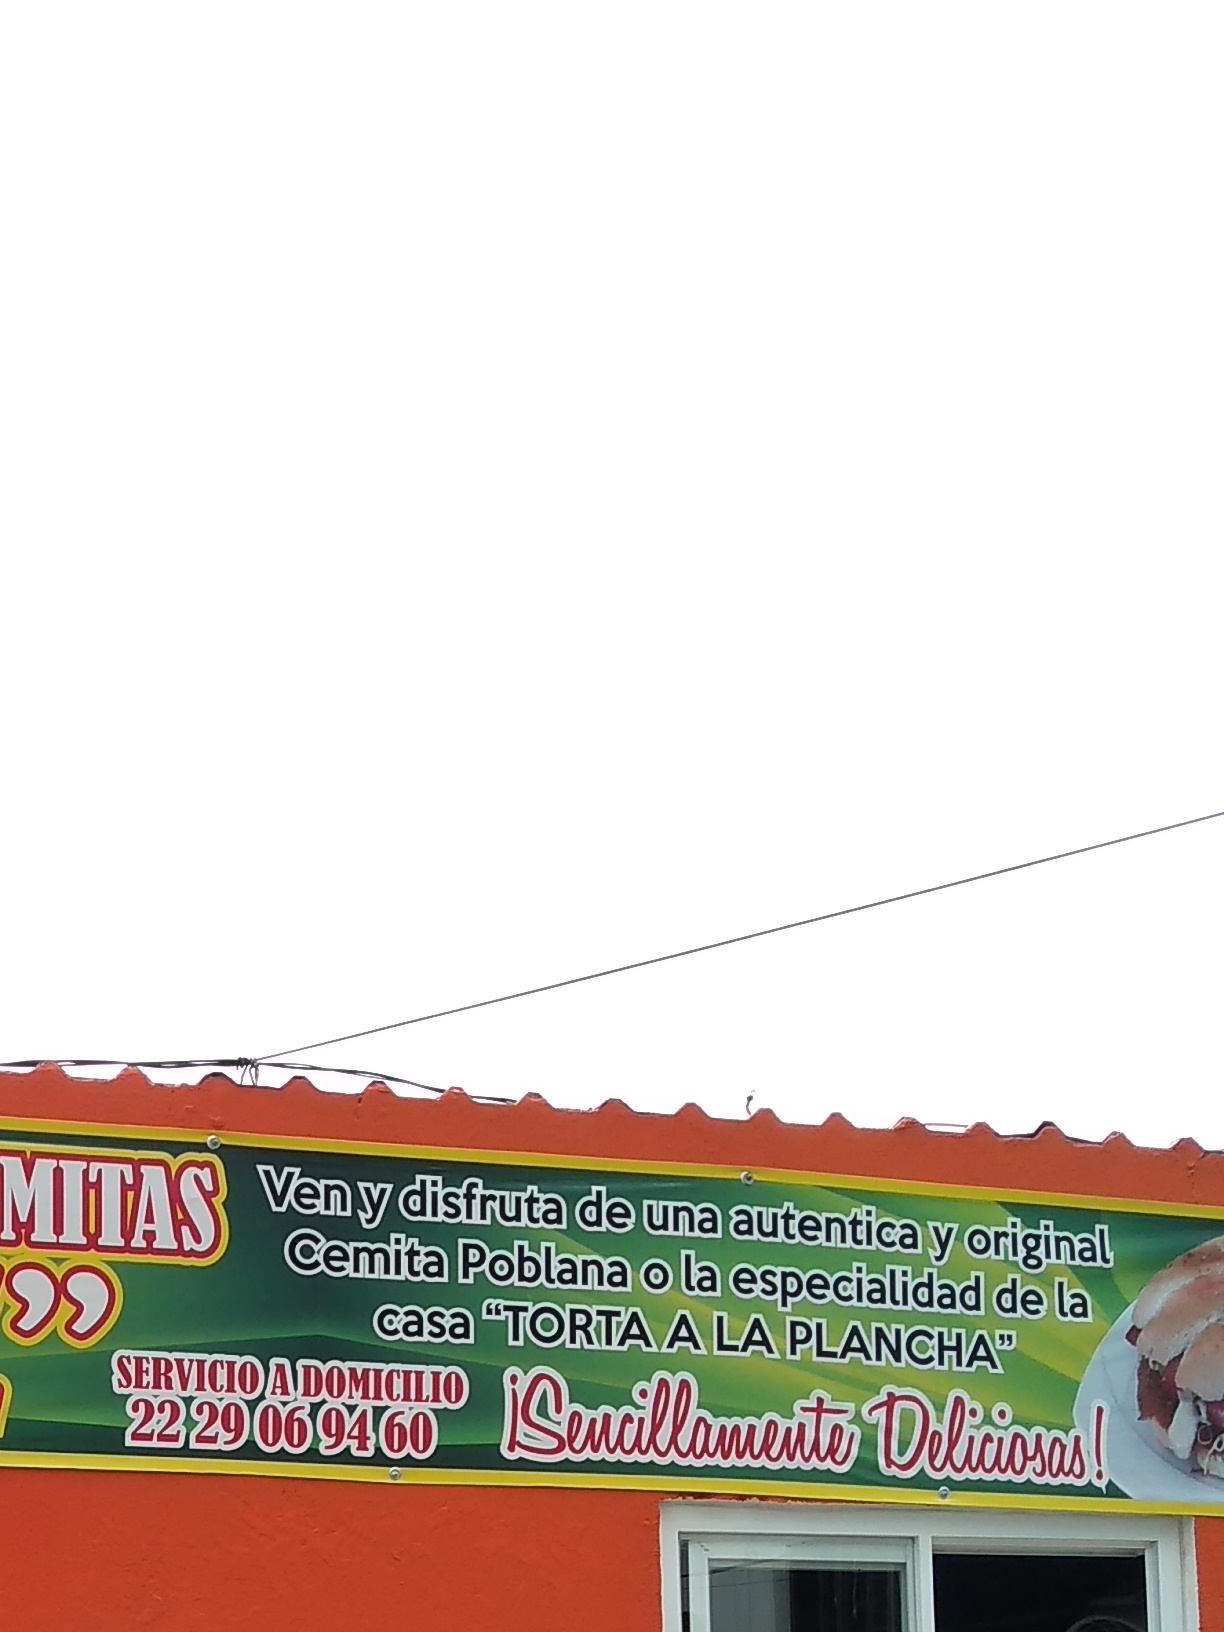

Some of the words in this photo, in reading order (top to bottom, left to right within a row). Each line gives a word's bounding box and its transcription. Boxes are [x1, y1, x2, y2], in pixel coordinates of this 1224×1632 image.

[258, 1165, 351, 1215] Ven
[357, 1181, 391, 1227] y
[399, 1175, 565, 1229] disfruta
[577, 1187, 634, 1231] de
[647, 1201, 720, 1237] una
[731, 1204, 919, 1252] autentica
[930, 1222, 956, 1265] y
[966, 1220, 1111, 1272] original
[286, 1230, 446, 1281] Cemita
[459, 1240, 631, 1292] Poblana
[641, 1260, 670, 1292] o
[683, 1252, 719, 1296] la
[731, 1263, 982, 1310] especialidad
[995, 1275, 1046, 1317] de
[1057, 1279, 1091, 1320] la
[374, 1305, 472, 1342] casa
[663, 1312, 704, 1352] A
[715, 1314, 777, 1357] LA
[116, 1354, 261, 1396] SERVICIO
[270, 1362, 291, 1397] A
[300, 1364, 465, 1405] DOMICILIO
[129, 1398, 182, 1444] 22
[193, 1401, 246, 1446] 29
[257, 1403, 309, 1450] 06
[320, 1407, 372, 1453] 94
[383, 1410, 434, 1455] 60
[505, 1372, 856, 1467] ¡Sencillamente
[868, 1386, 1108, 1482] Deliciosas!
